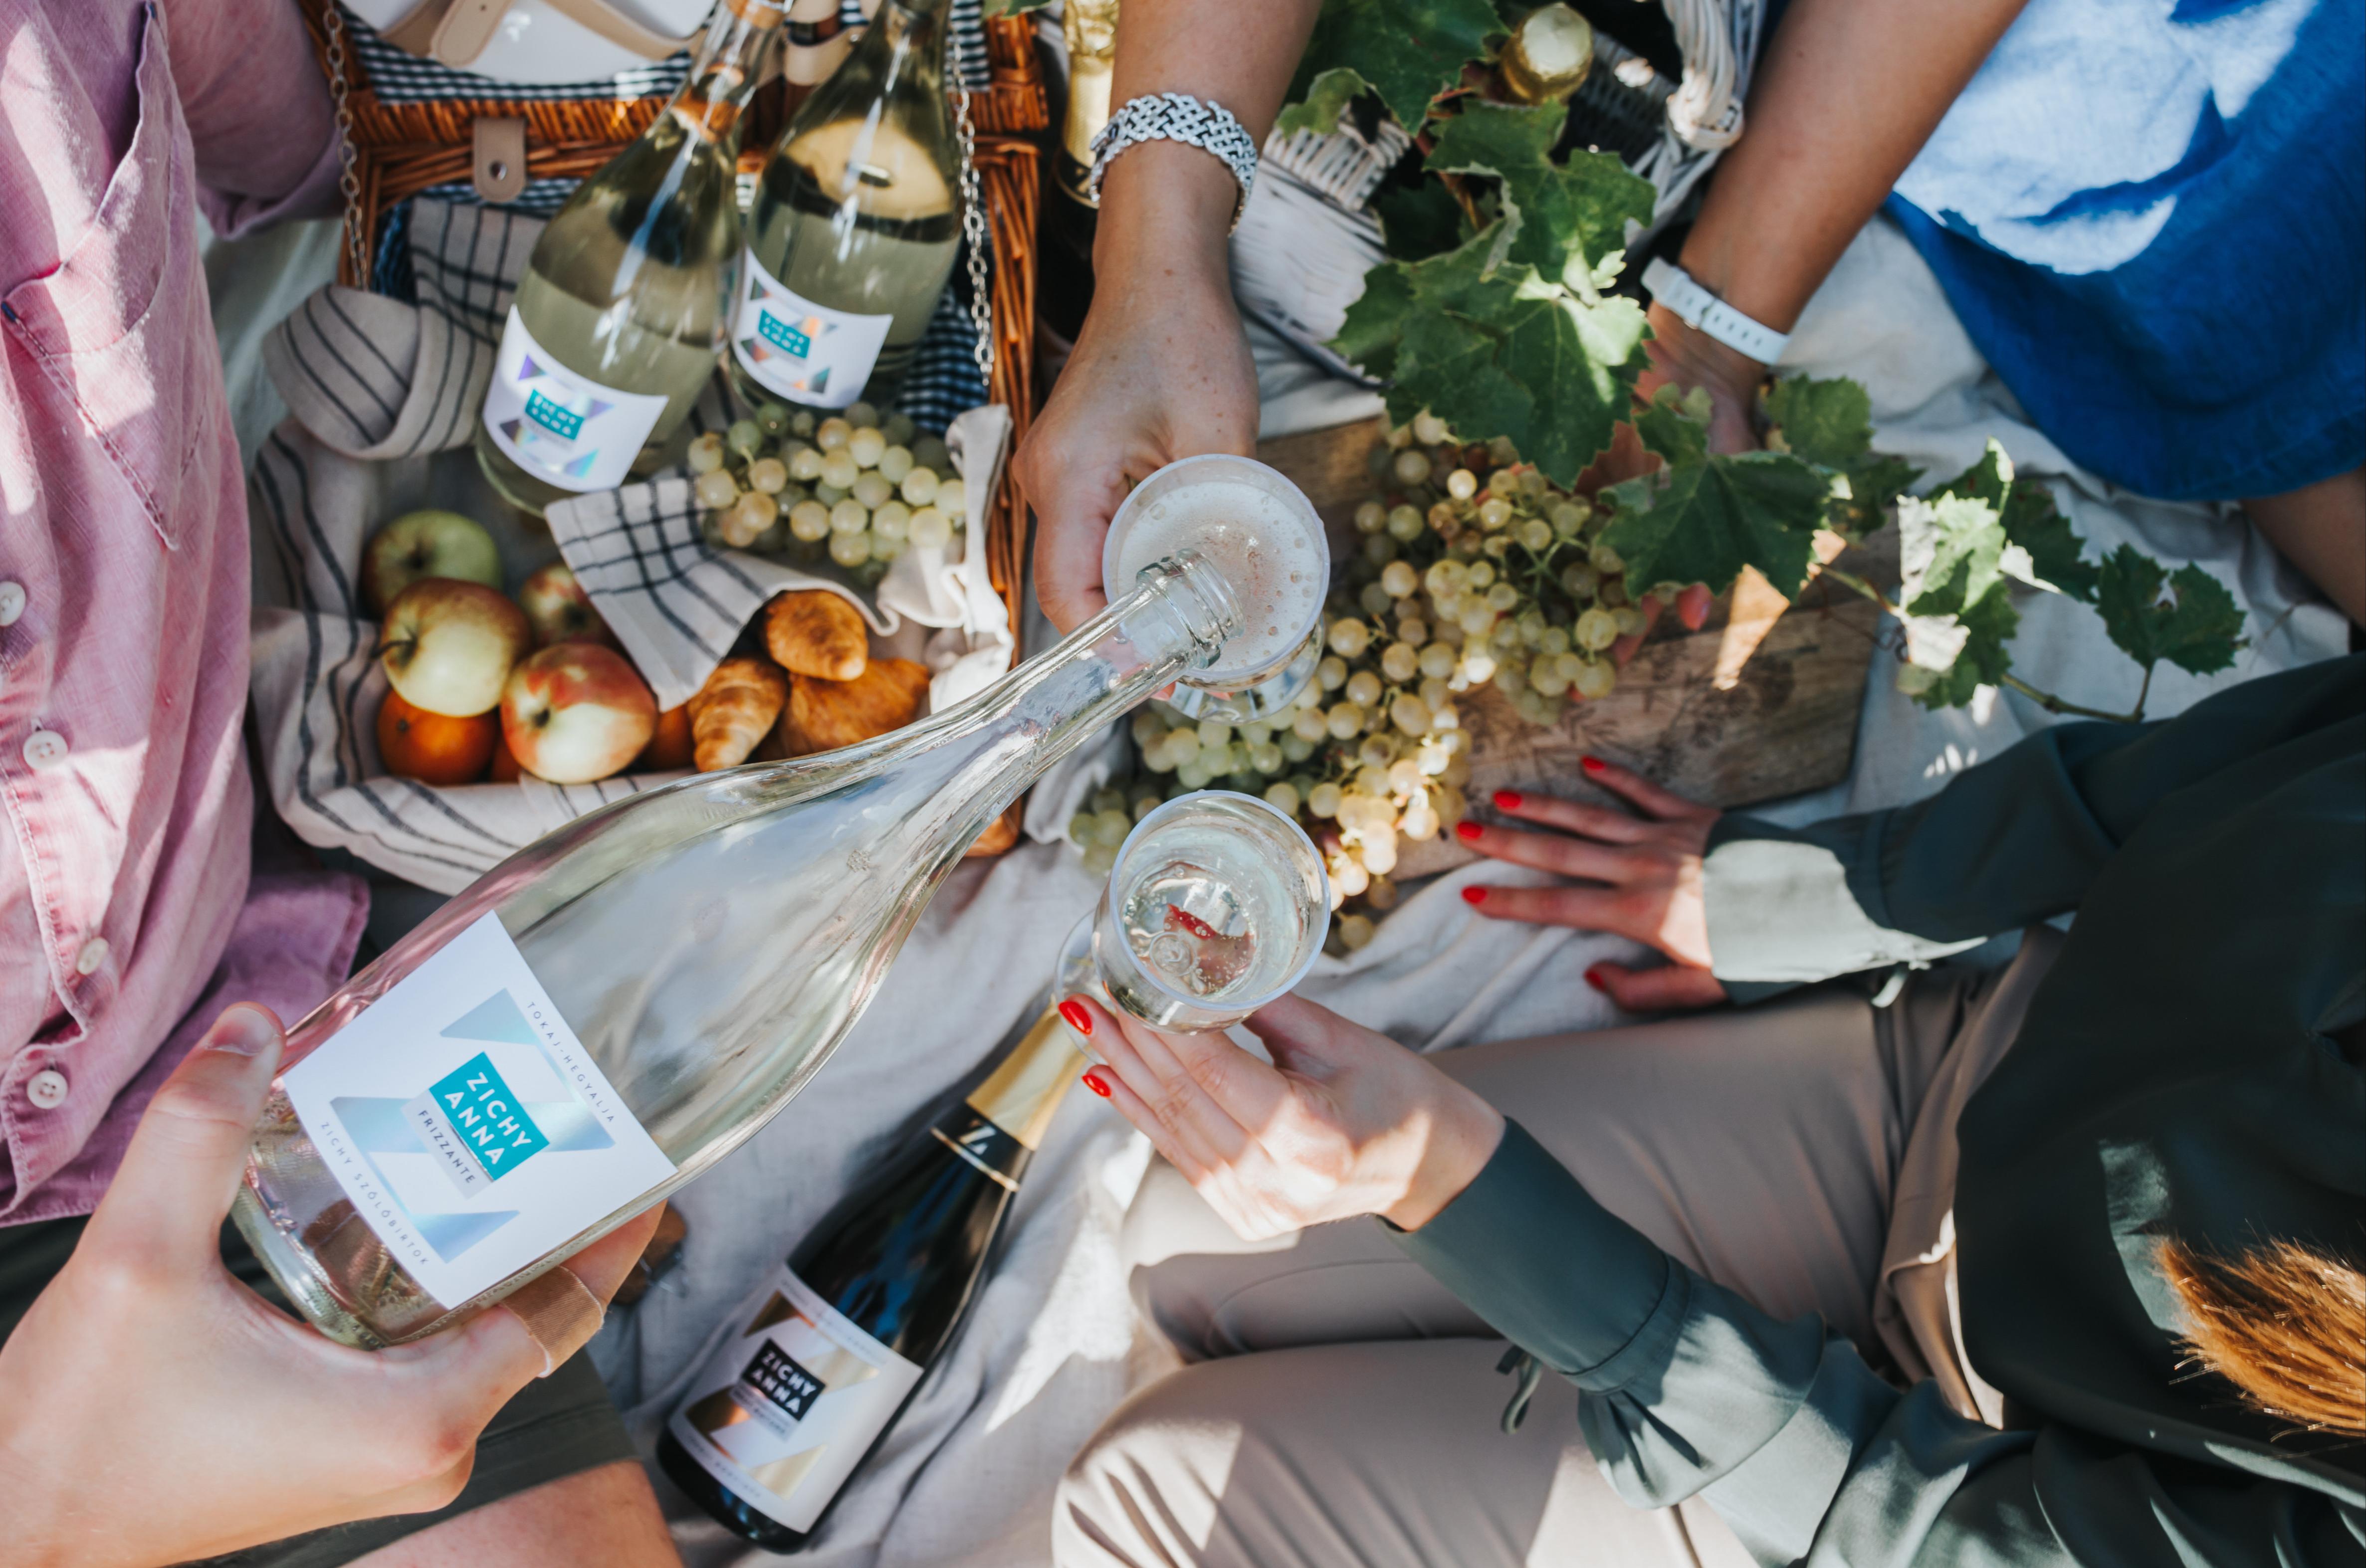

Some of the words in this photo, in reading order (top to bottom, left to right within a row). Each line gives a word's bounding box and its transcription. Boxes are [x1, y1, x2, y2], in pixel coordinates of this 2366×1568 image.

[527, 1001, 615, 1122] TOKAJ-HEGYALJA
[321, 1122, 352, 1165] ZICHY
[444, 1092, 505, 1164] ANNA
[466, 1072, 532, 1147] ZICHY
[418, 1110, 475, 1183] FRIZZANTE
[751, 1369, 801, 1413] ANNA
[761, 1350, 817, 1396] ZICHY
